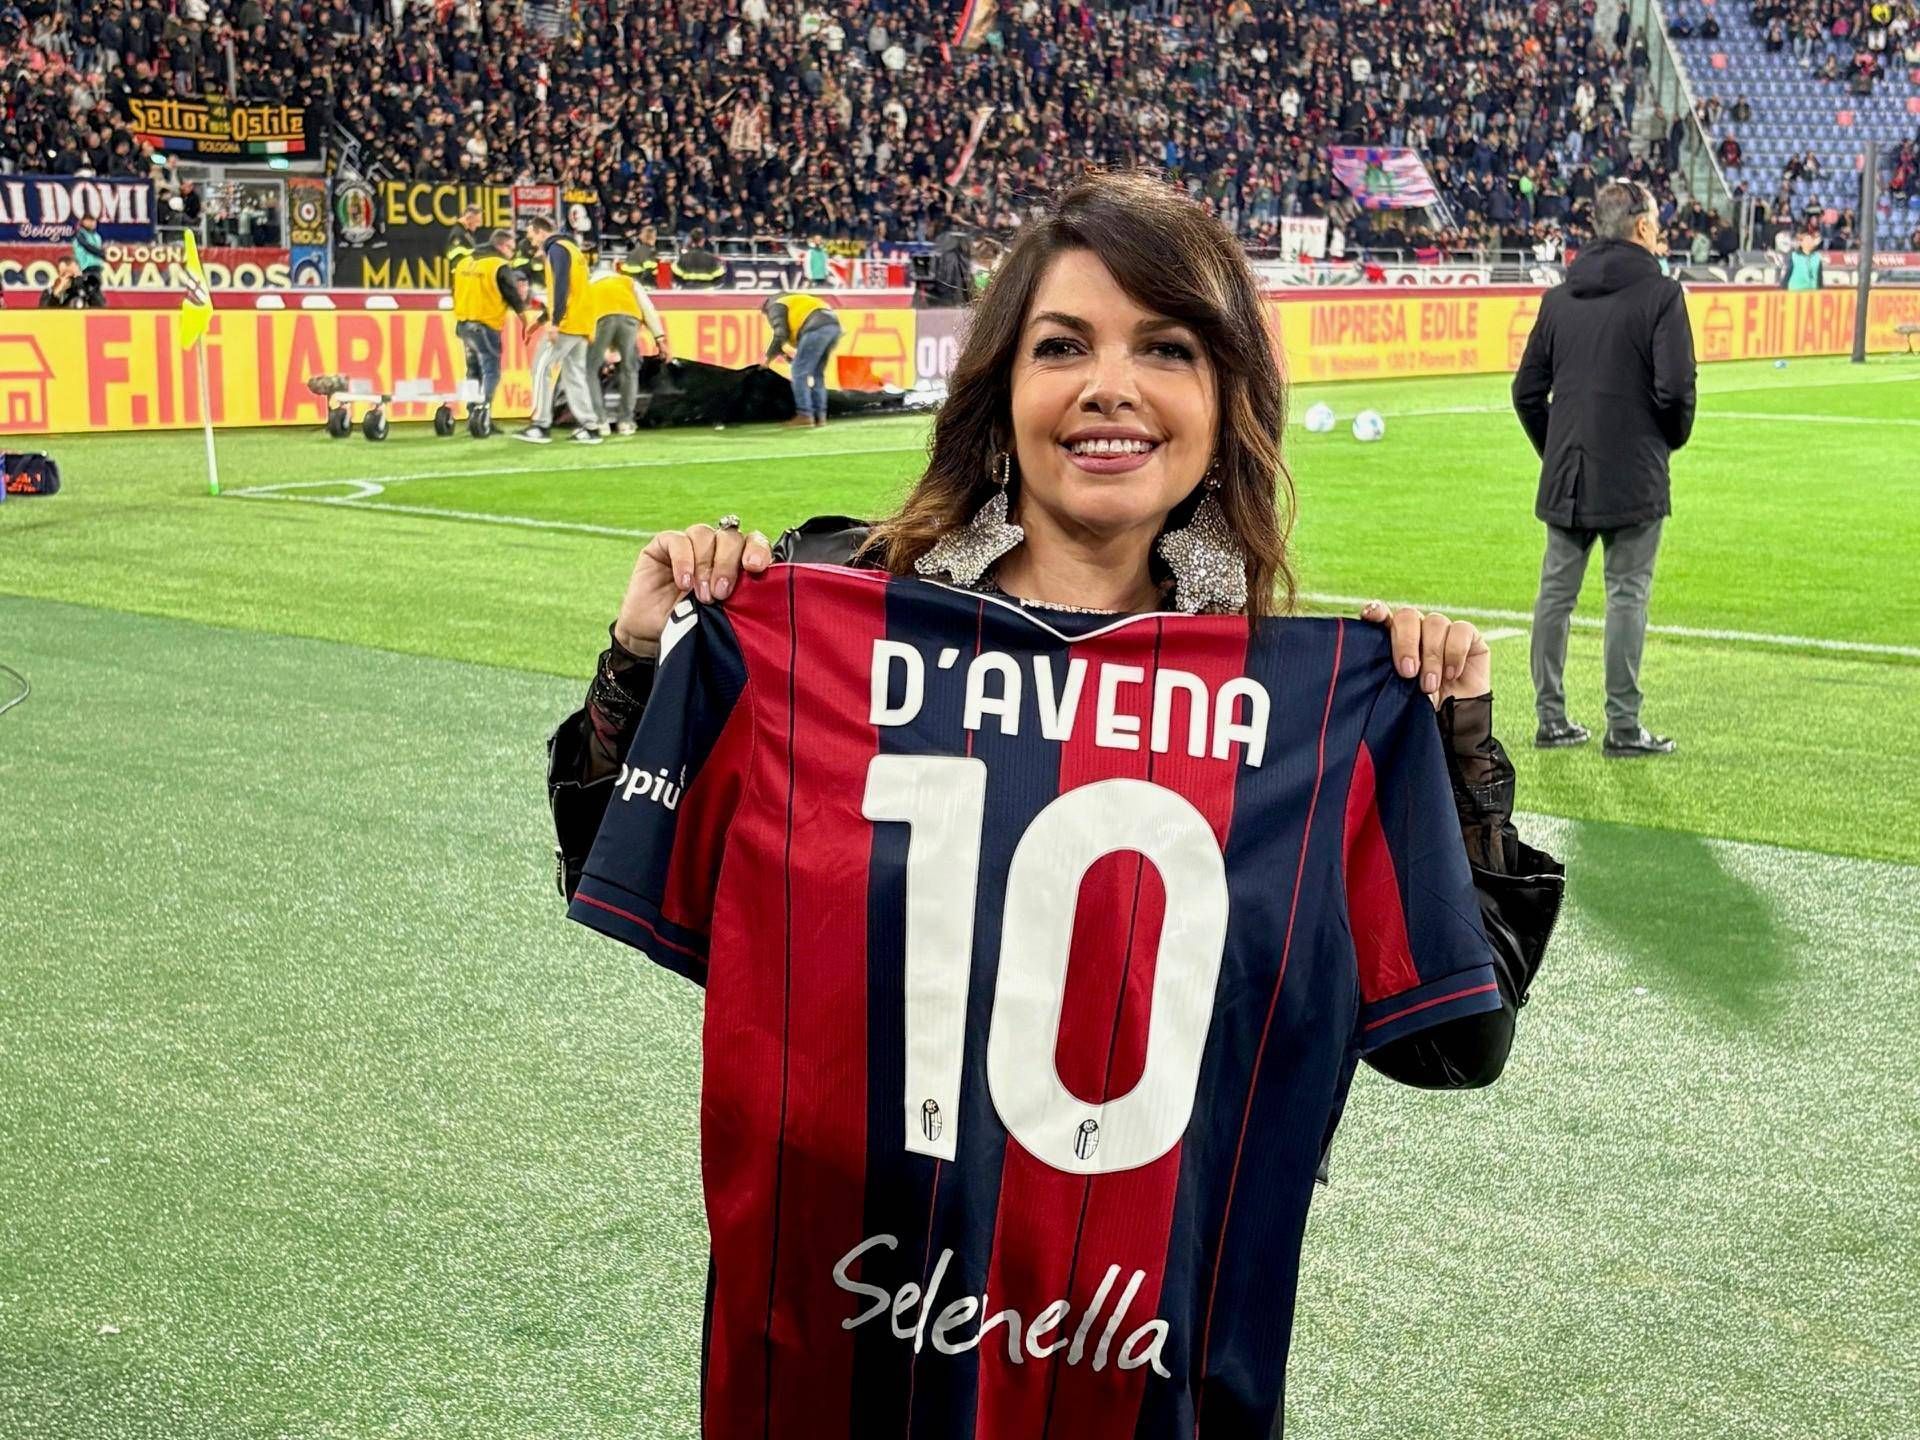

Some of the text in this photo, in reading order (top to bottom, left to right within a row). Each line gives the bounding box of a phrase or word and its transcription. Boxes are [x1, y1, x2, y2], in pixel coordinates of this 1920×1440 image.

[231, 105, 304, 141] Ostile
[198, 140, 241, 154] BOLOGNA
[35, 181, 151, 224] DOMI
[378, 180, 512, 229] ECCHIE
[18, 222, 76, 242] Bologna
[105, 245, 188, 263] OLOGN
[0, 259, 292, 289] COMANDOS
[1310, 301, 1479, 346] IMPRESA EDILE
[256, 313, 461, 422] IARIA
[869, 638, 1271, 768] D'AVENA
[862, 754, 1229, 1175] 10
[832, 1233, 1172, 1379] Selenella
